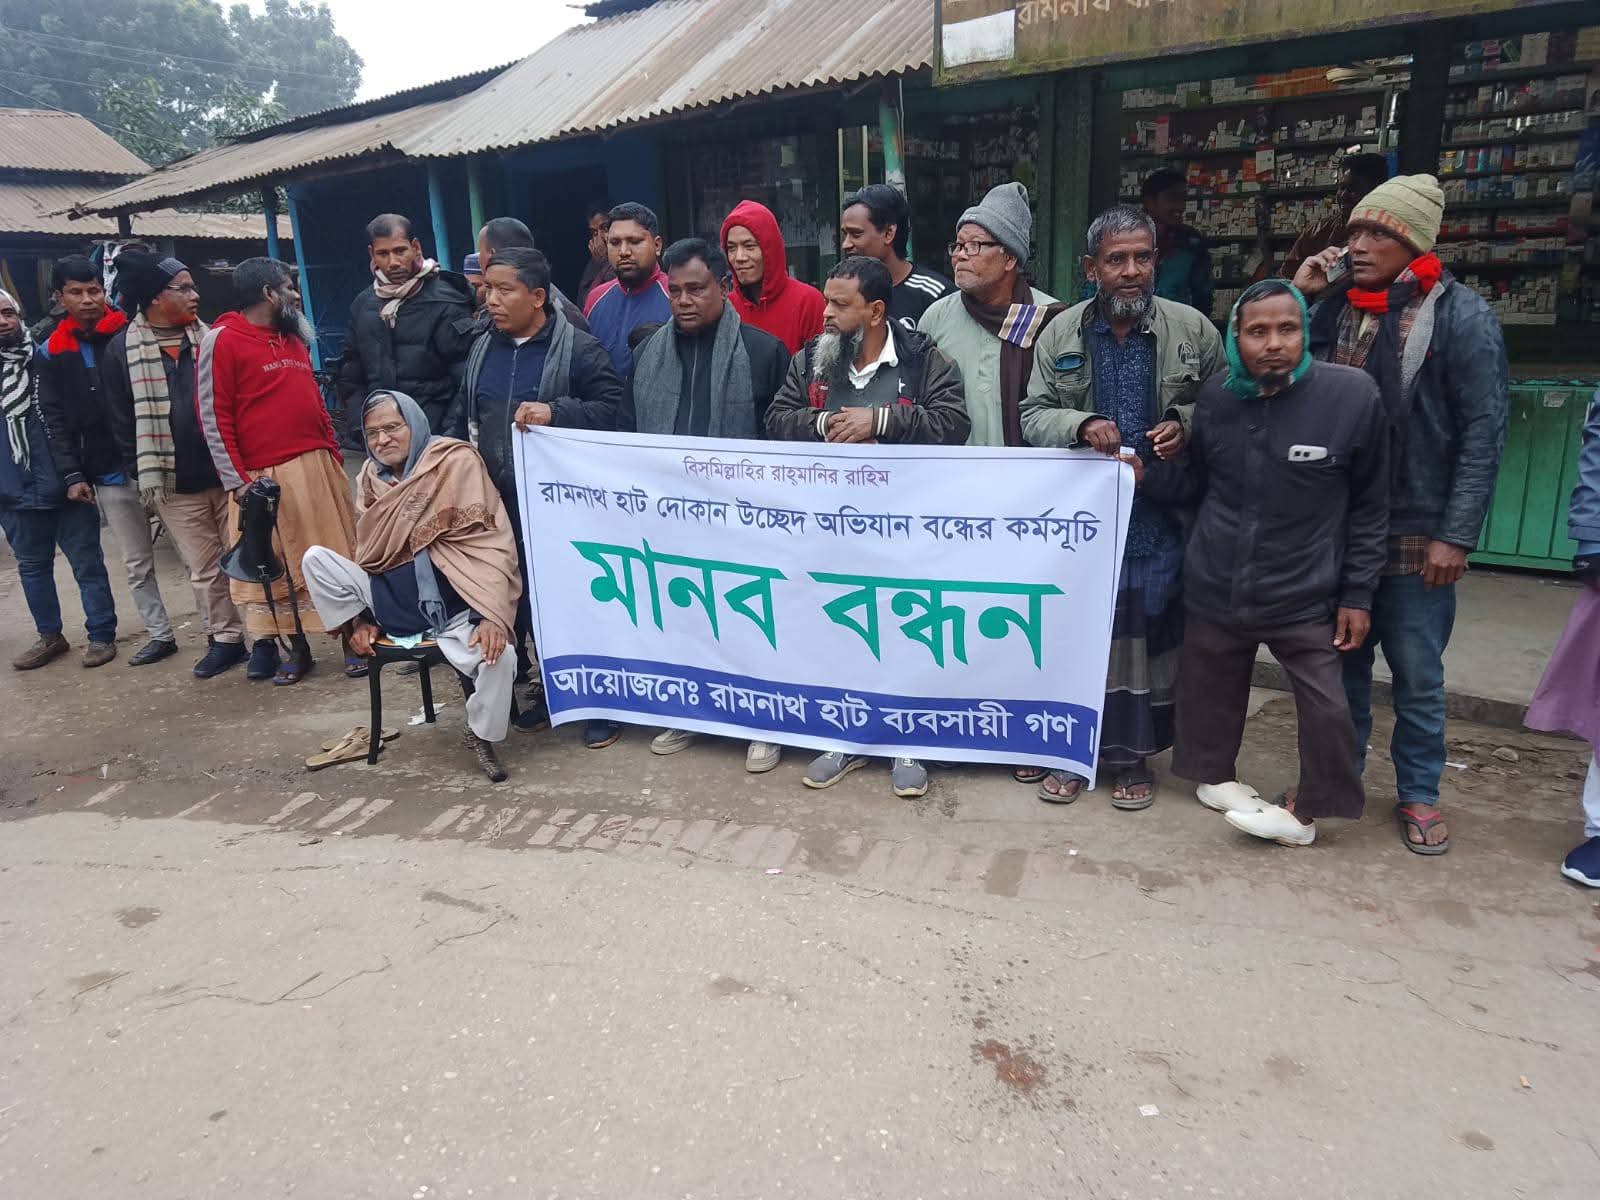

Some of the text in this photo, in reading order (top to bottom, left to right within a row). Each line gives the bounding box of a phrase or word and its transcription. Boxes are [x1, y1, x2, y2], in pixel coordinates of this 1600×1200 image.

[844, 464, 890, 488] রাহিম
[538, 480, 1102, 552] রামনাথ হাট দোকান উচ্ছেদ অভিযান বন্ধের কর্মসূচি
[569, 538, 1067, 671] মানব বন্ধন
[550, 664, 700, 706] আয়োজনেঃ
[706, 682, 809, 724] রামনাথ
[815, 693, 872, 732] হাট
[878, 701, 1015, 739] ব্যবসায়ী
[1025, 709, 1079, 746] গণ
